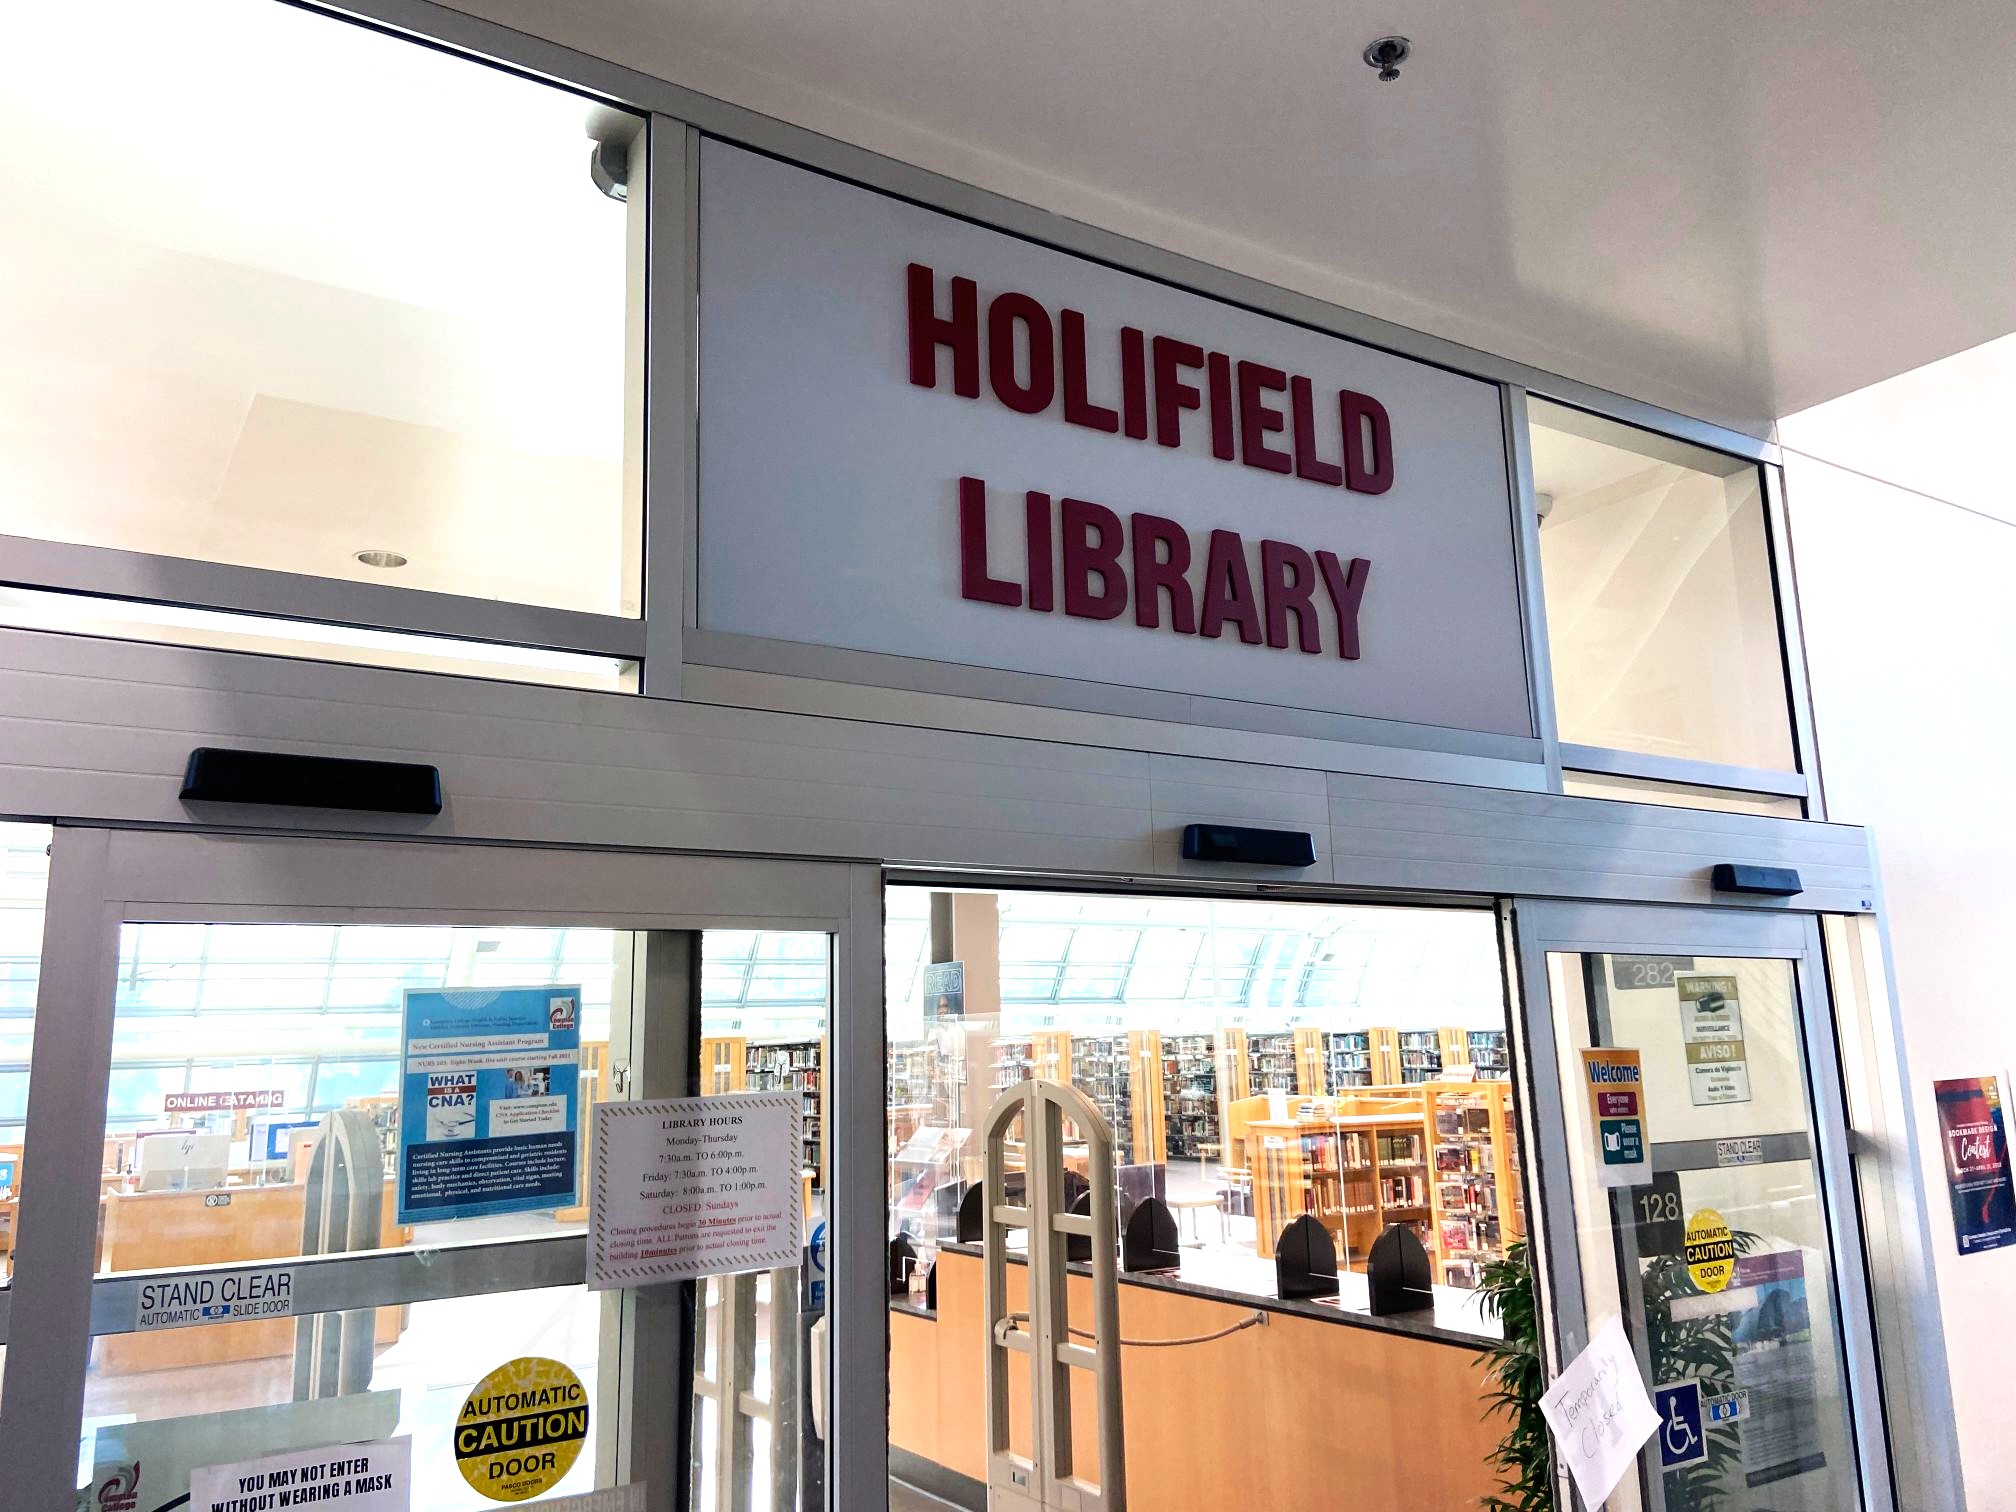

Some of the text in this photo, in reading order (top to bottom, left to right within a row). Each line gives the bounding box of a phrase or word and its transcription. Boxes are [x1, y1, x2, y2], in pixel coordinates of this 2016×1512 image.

[907, 262, 1394, 495] HOLIFIELD
[959, 476, 1371, 659] LIBRARY
[926, 970, 961, 993] READ
[1633, 962, 1674, 985] 282
[430, 1074, 475, 1086] WHAT
[1588, 1060, 1639, 1083] Welcome
[167, 1095, 216, 1108] ONLINE
[428, 1094, 474, 1108] CNA?
[1607, 1093, 1629, 1107] Everyone
[662, 1116, 743, 1130] LIBRARY HOURS
[1948, 1127, 1977, 1137] BOOKMARK
[666, 1133, 738, 1146] Monday-Thursday
[1718, 1142, 1739, 1156] STAND
[1961, 1135, 1991, 1160] Contest
[413, 1152, 439, 1160] Certified
[493, 1146, 513, 1154] provide
[696, 1151, 709, 1160] TO
[710, 1150, 744, 1160] 6:00p.m.
[438, 1174, 461, 1183] practice
[711, 1167, 724, 1176] TO
[725, 1165, 758, 1176] 4:00p.m.
[719, 1183, 732, 1192] TO
[705, 1200, 739, 1211] Sundays
[1640, 1192, 1679, 1224] 128
[610, 1227, 637, 1236] Closing
[639, 1223, 676, 1234] procedures
[708, 1217, 736, 1227] Minutes
[1686, 1226, 1728, 1242] AUTOMATIC
[1686, 1242, 1733, 1262] CAUTION
[1700, 1265, 1725, 1279] DOOR
[141, 1273, 291, 1310] STAND CLEAR
[140, 1299, 289, 1326] AUTOMATIC SLIDE DOOR
[463, 1384, 580, 1418] AUTOMATIC
[458, 1410, 585, 1453] CAUTION
[1581, 1391, 1623, 1459] Closed
[238, 1457, 369, 1494] YOU MAY NOT ENTER
[489, 1452, 555, 1480] DOOR
[211, 1473, 393, 1512] WITHOUT WEARING A MASK
